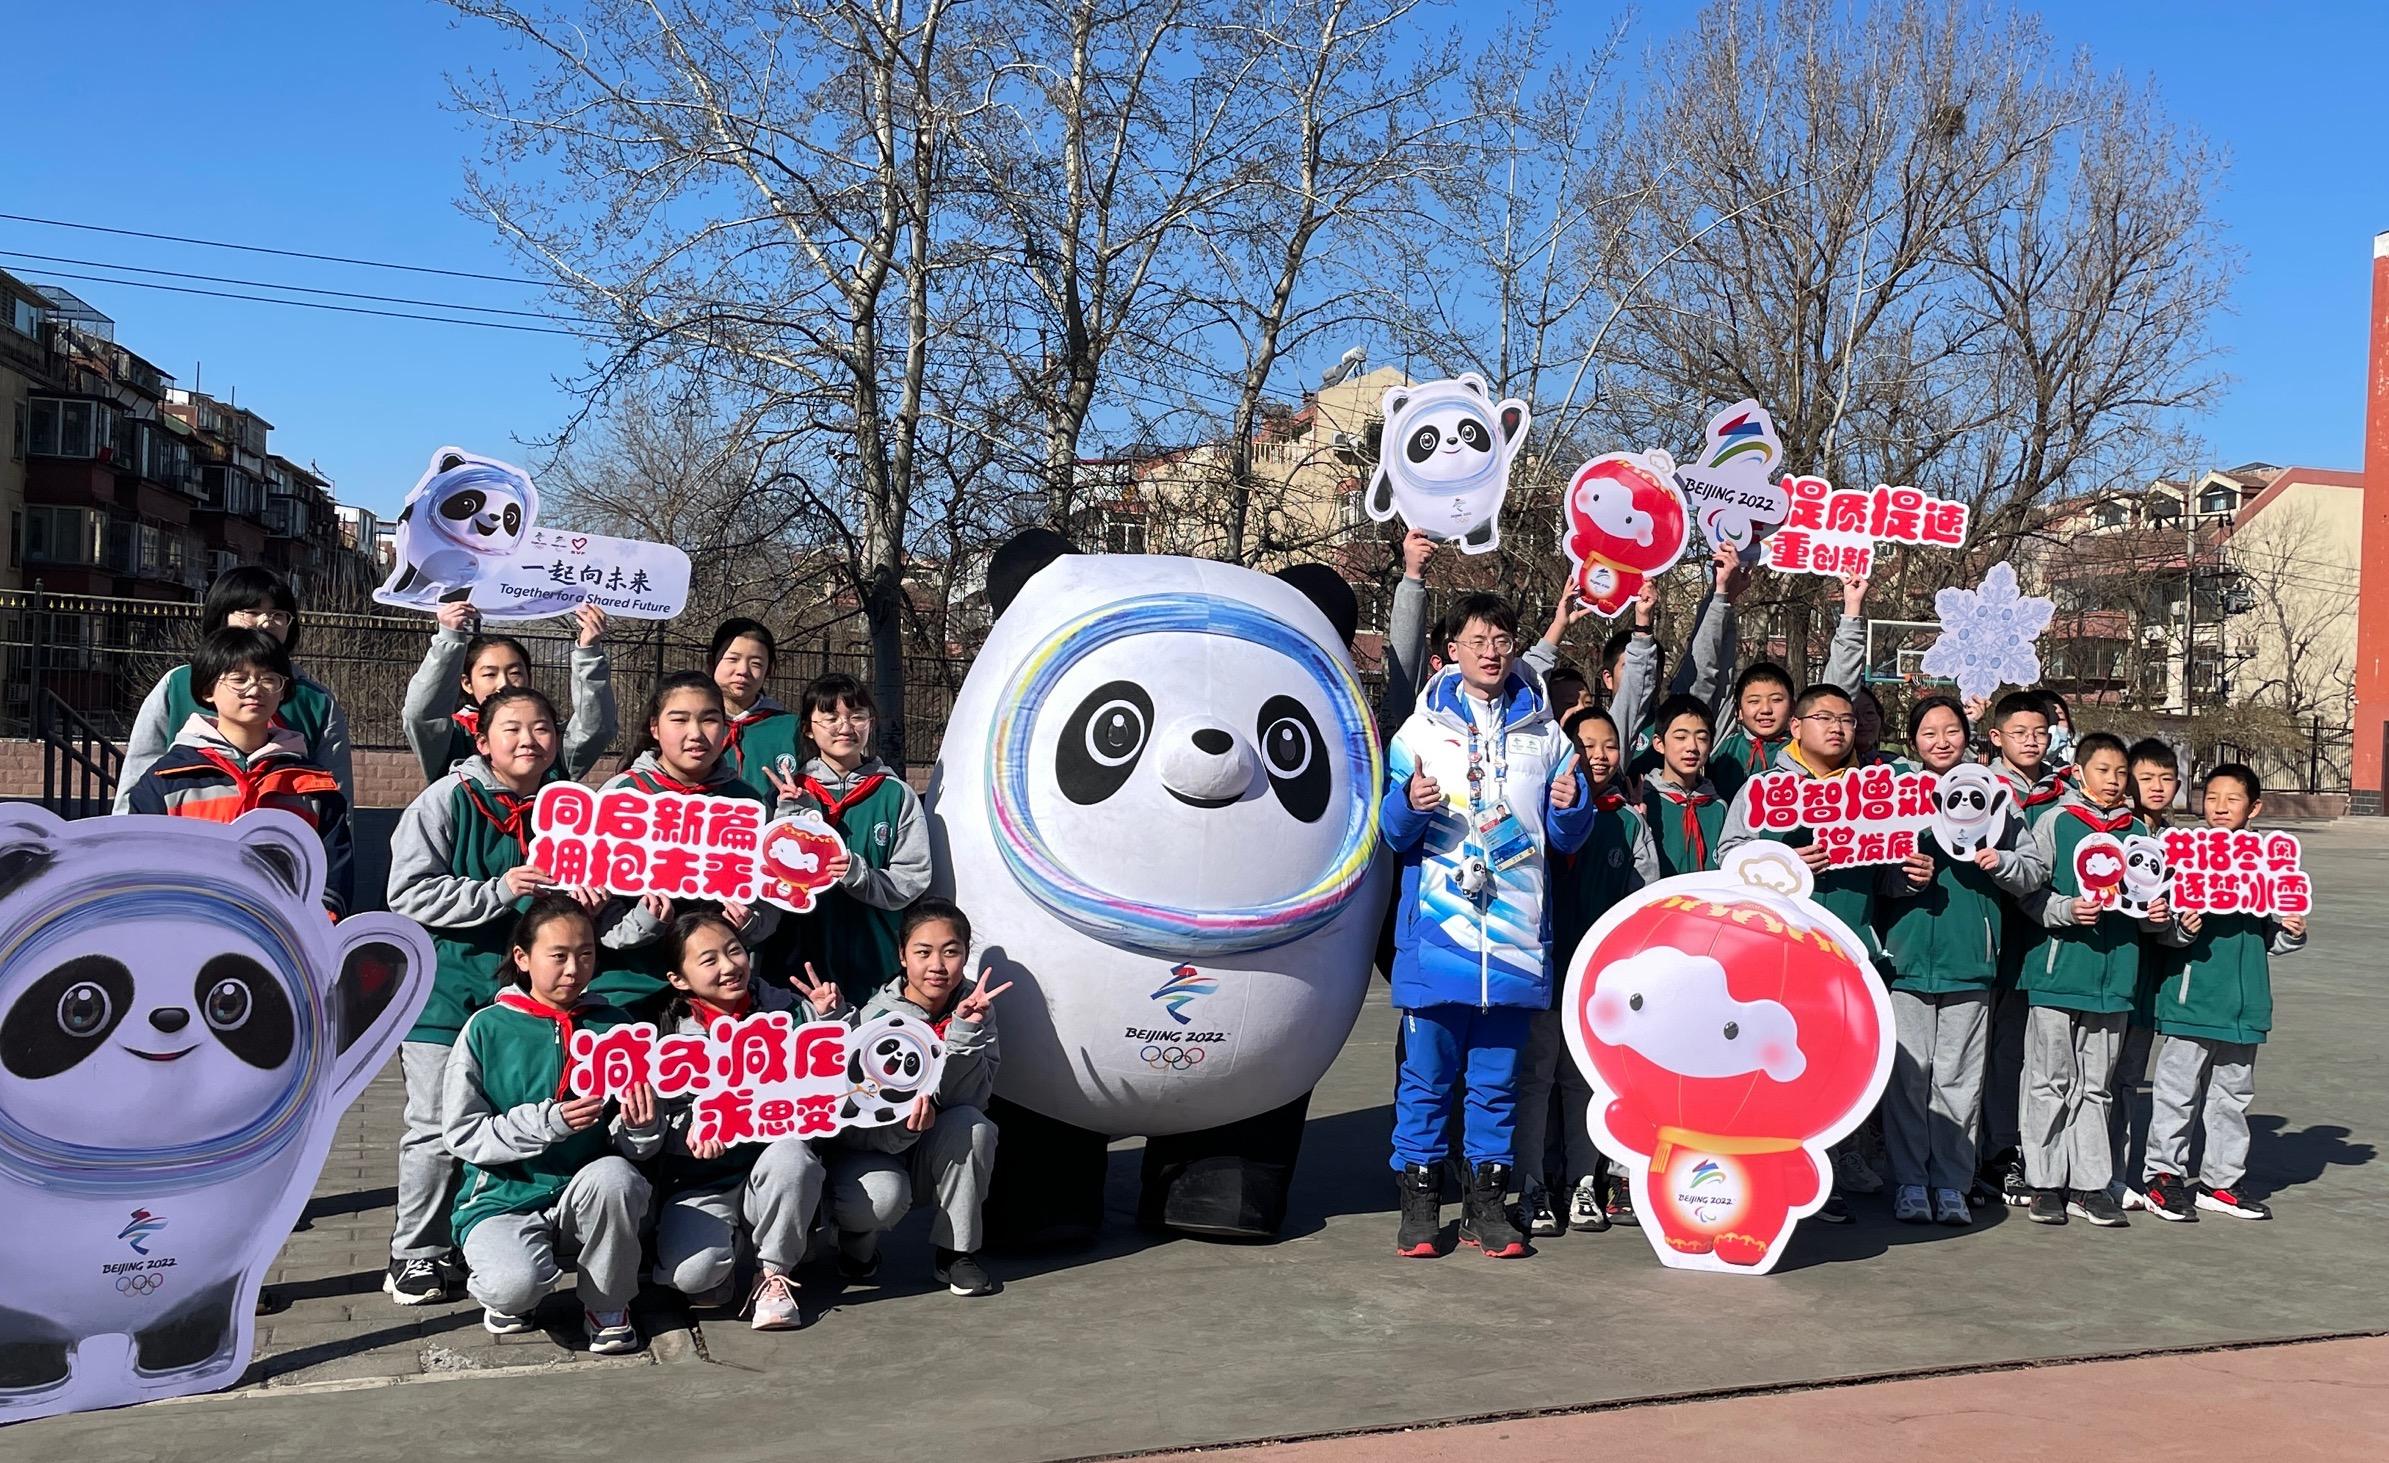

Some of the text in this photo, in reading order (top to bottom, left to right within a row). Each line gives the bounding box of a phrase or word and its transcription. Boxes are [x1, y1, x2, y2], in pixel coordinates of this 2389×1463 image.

[1684, 477, 1775, 512] BEIJING 2022
[1780, 477, 1966, 544] 提质提速
[1772, 531, 1871, 575] 重创新
[521, 559, 652, 595] 一起向未来
[500, 583, 671, 613] Together for a Shared Future
[1748, 768, 1938, 828] 增智增效
[538, 787, 760, 851] 同启新篇
[534, 836, 754, 899] 拥抱未来
[2164, 831, 2297, 872] 共话冬奥
[2174, 872, 2309, 912] 逐梦冰雪
[1125, 1027, 1227, 1043] BEIJING 2022
[577, 1017, 846, 1097] 减负减压
[699, 1089, 837, 1143] 求思变
[1678, 1194, 1733, 1205] BEIJING 2022
[103, 1258, 178, 1275] BEIJING 2022
